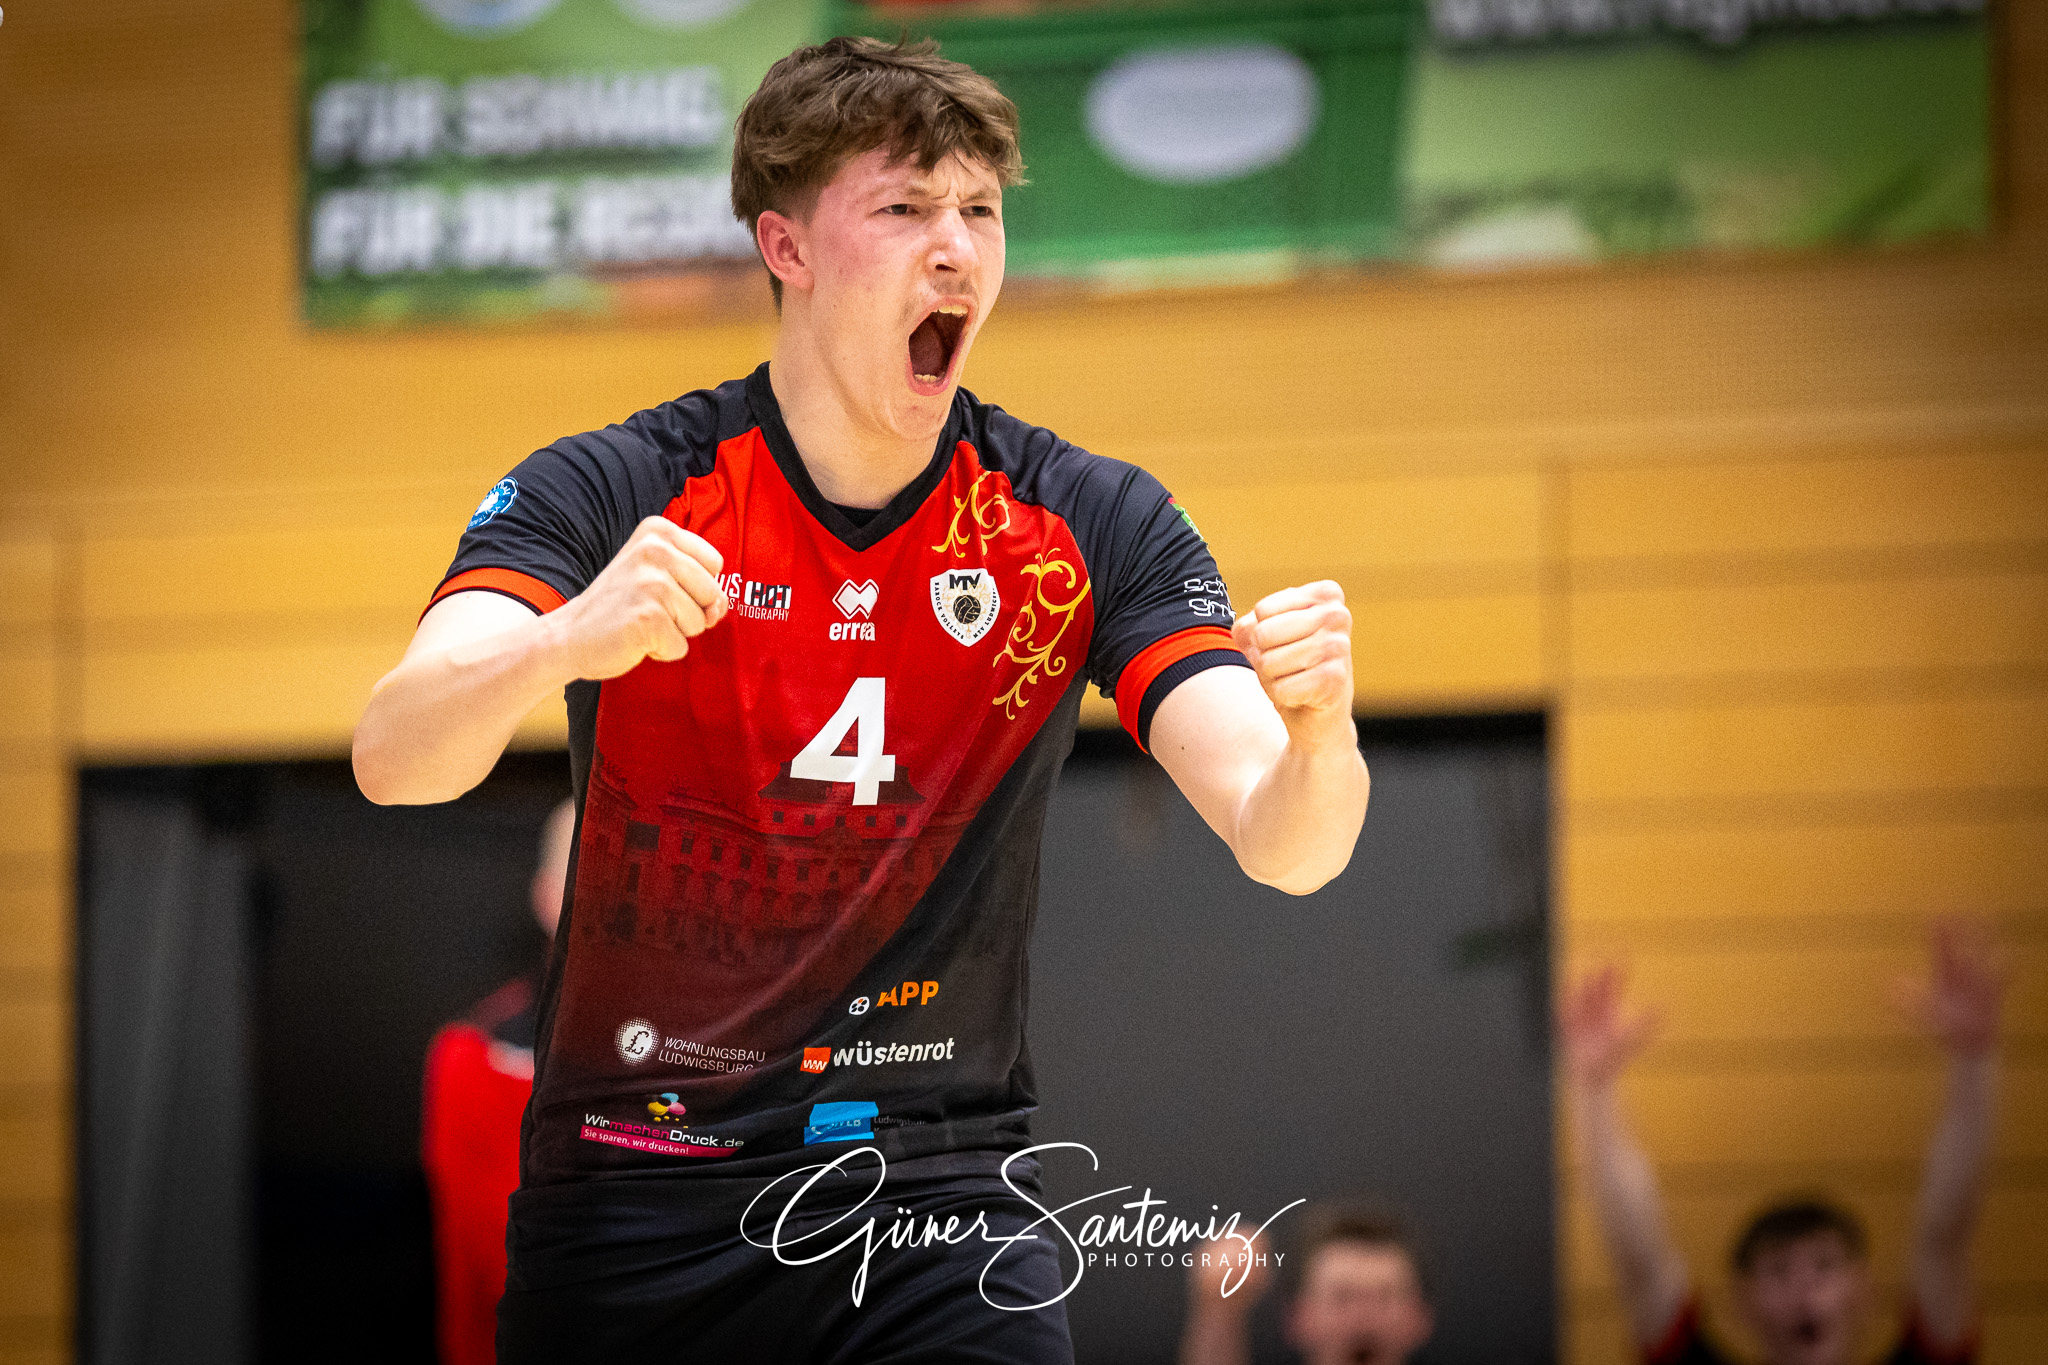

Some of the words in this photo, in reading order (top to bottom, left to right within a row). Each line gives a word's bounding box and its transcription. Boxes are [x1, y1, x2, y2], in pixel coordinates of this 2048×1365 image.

[949, 573, 981, 590] MTV
[790, 677, 896, 806] 4
[665, 1036, 766, 1062] WOHNUNGSBAU
[584, 1128, 598, 1139] Sie
[599, 1131, 630, 1146] sparen,
[633, 1138, 647, 1148] wir
[648, 1140, 689, 1155] drucken!
[585, 1113, 745, 1148] WirmachenDruck.de
